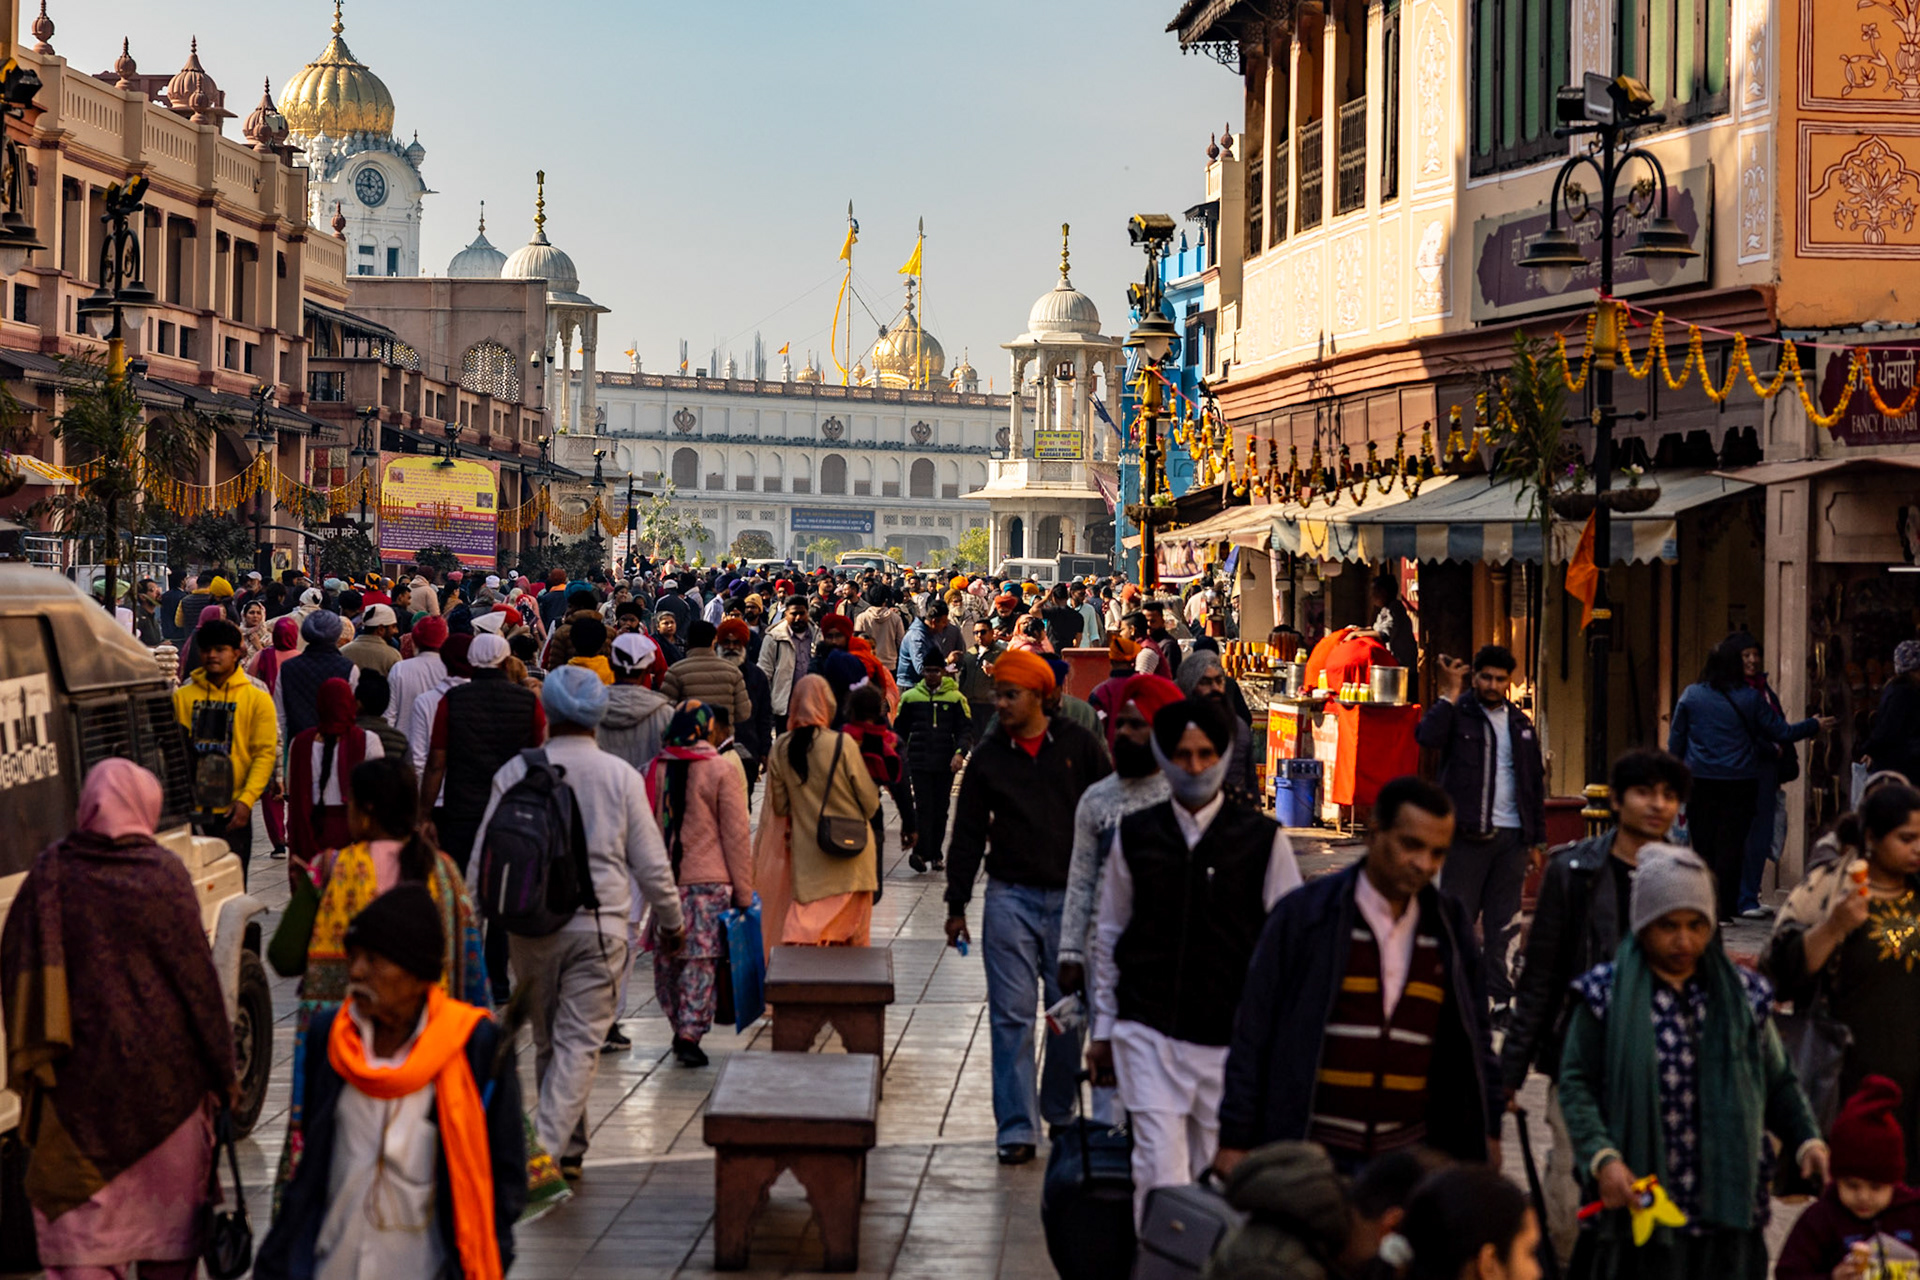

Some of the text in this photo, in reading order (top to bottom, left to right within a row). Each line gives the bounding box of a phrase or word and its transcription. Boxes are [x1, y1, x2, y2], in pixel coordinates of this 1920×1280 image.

[1877, 348, 1916, 390] ਪੰਜਾਬੀ
[1852, 412, 1918, 433] FANCY PUNJABI
